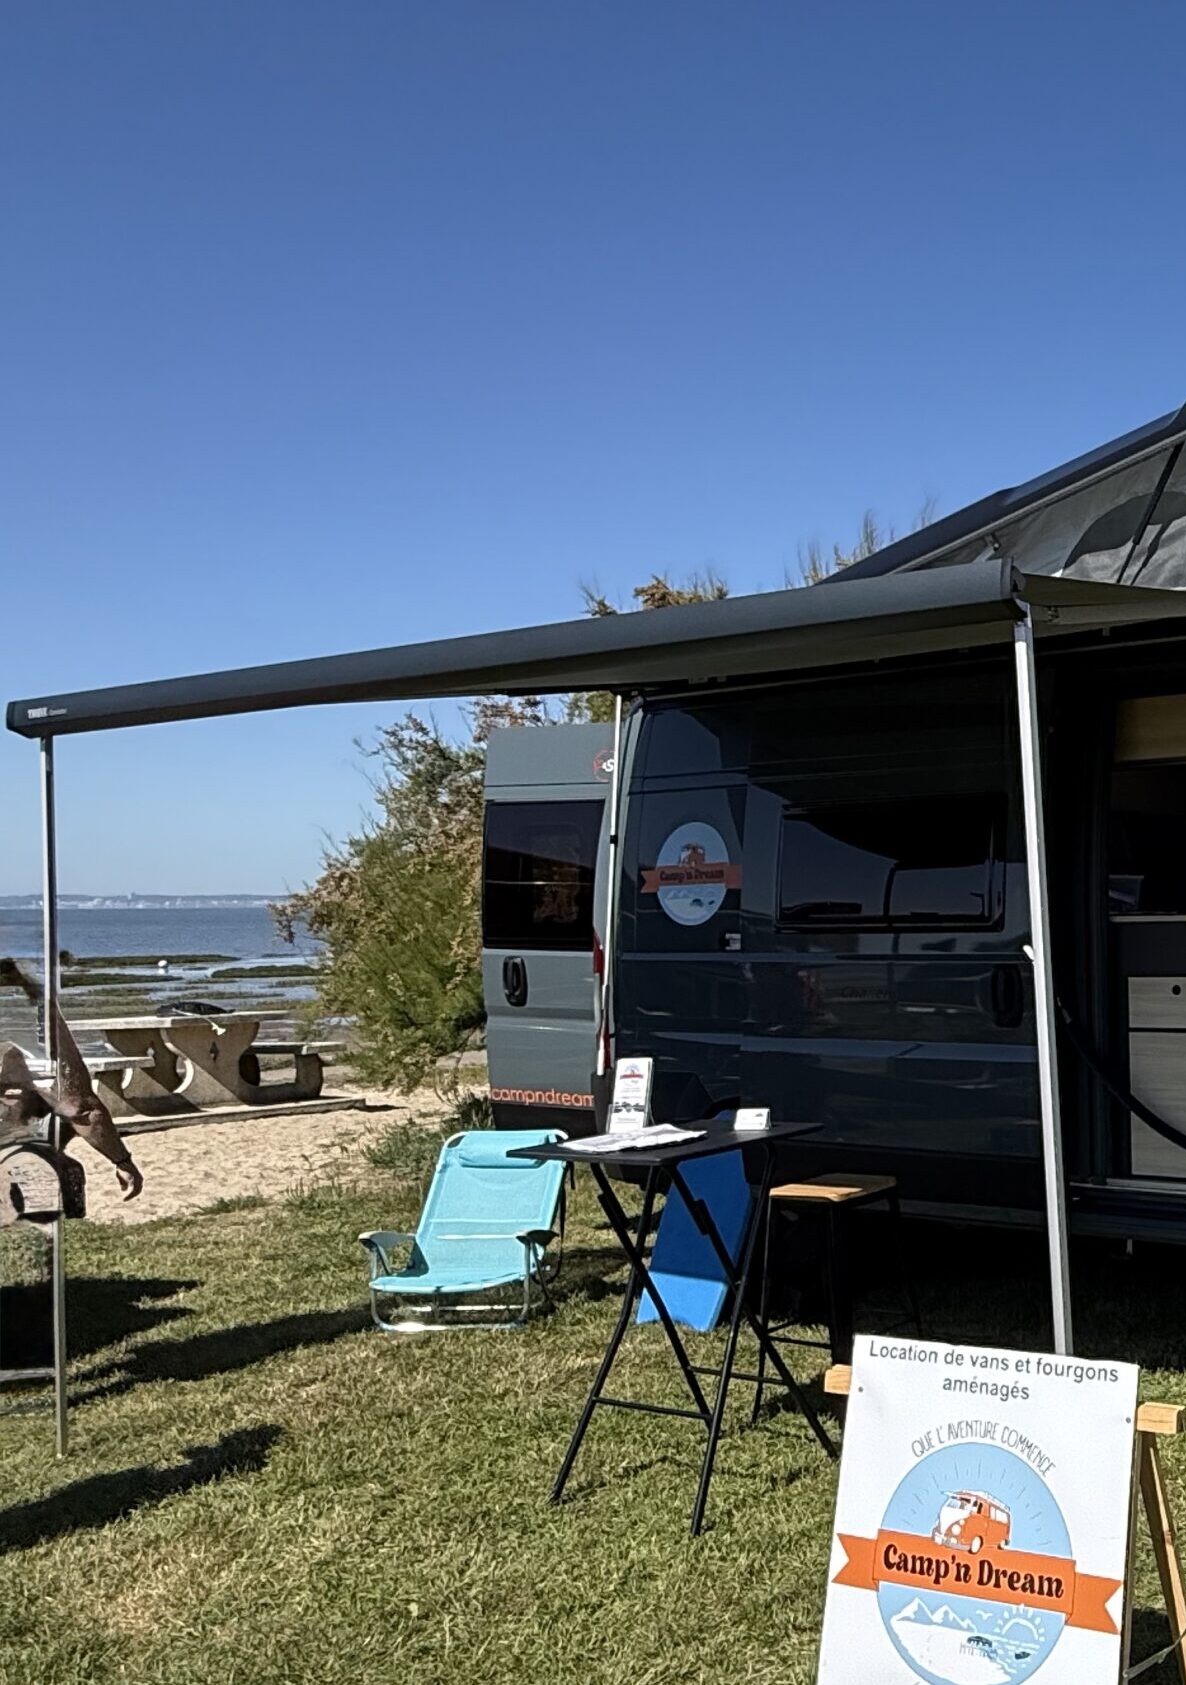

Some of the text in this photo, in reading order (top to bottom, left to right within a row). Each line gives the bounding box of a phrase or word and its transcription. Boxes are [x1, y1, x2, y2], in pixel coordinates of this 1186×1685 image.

[869, 1340, 1119, 1383] Location de vans et fourgons
[942, 1375, 1030, 1402] aménagés
[911, 1430, 935, 1458] QUE
[1001, 1425, 1056, 1477] COMMENCE
[882, 1543, 1065, 1600] Camp'n Dream
